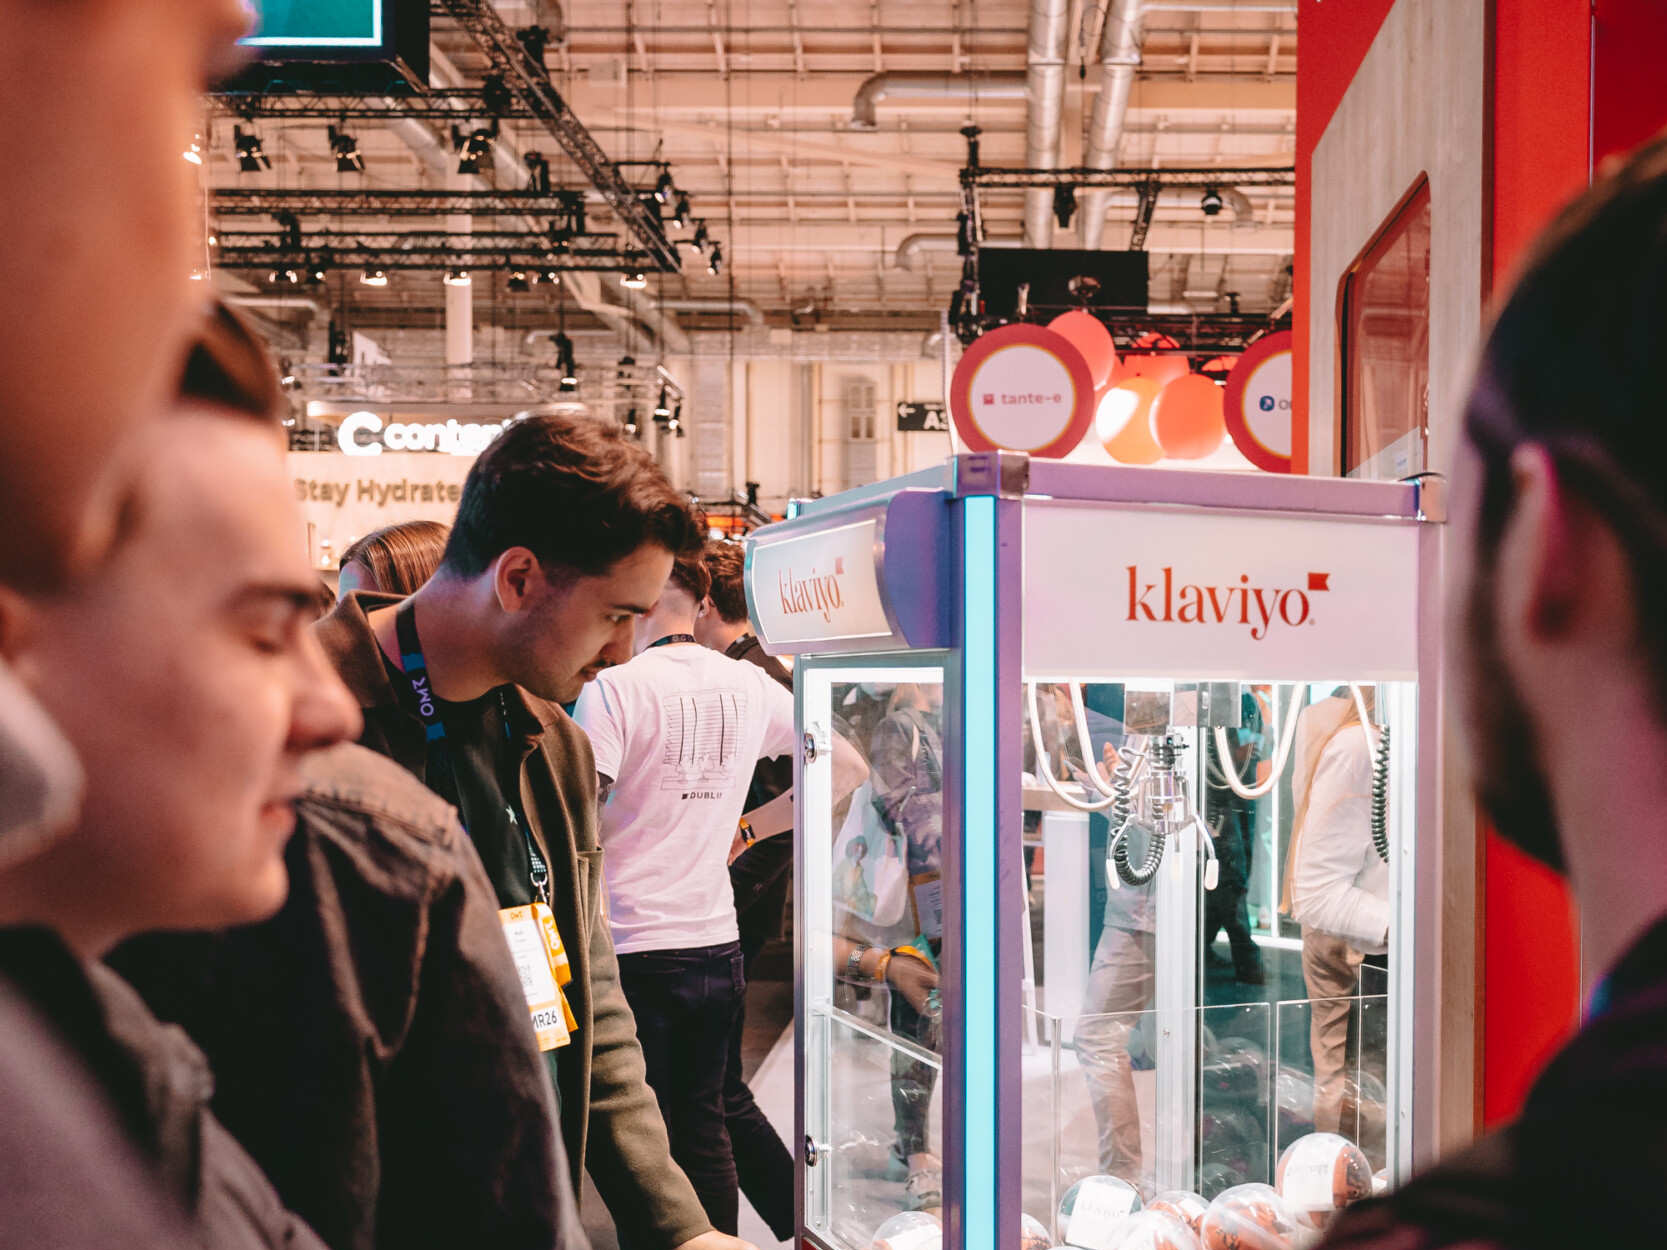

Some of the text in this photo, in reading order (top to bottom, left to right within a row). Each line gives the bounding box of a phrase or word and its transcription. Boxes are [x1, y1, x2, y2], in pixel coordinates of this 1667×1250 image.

[1000, 393, 1062, 405] tante-e
[293, 478, 349, 508] Stay
[779, 565, 841, 623] klaviyo
[1125, 565, 1311, 641] klaviyo
[690, 791, 722, 800] DUBLI
